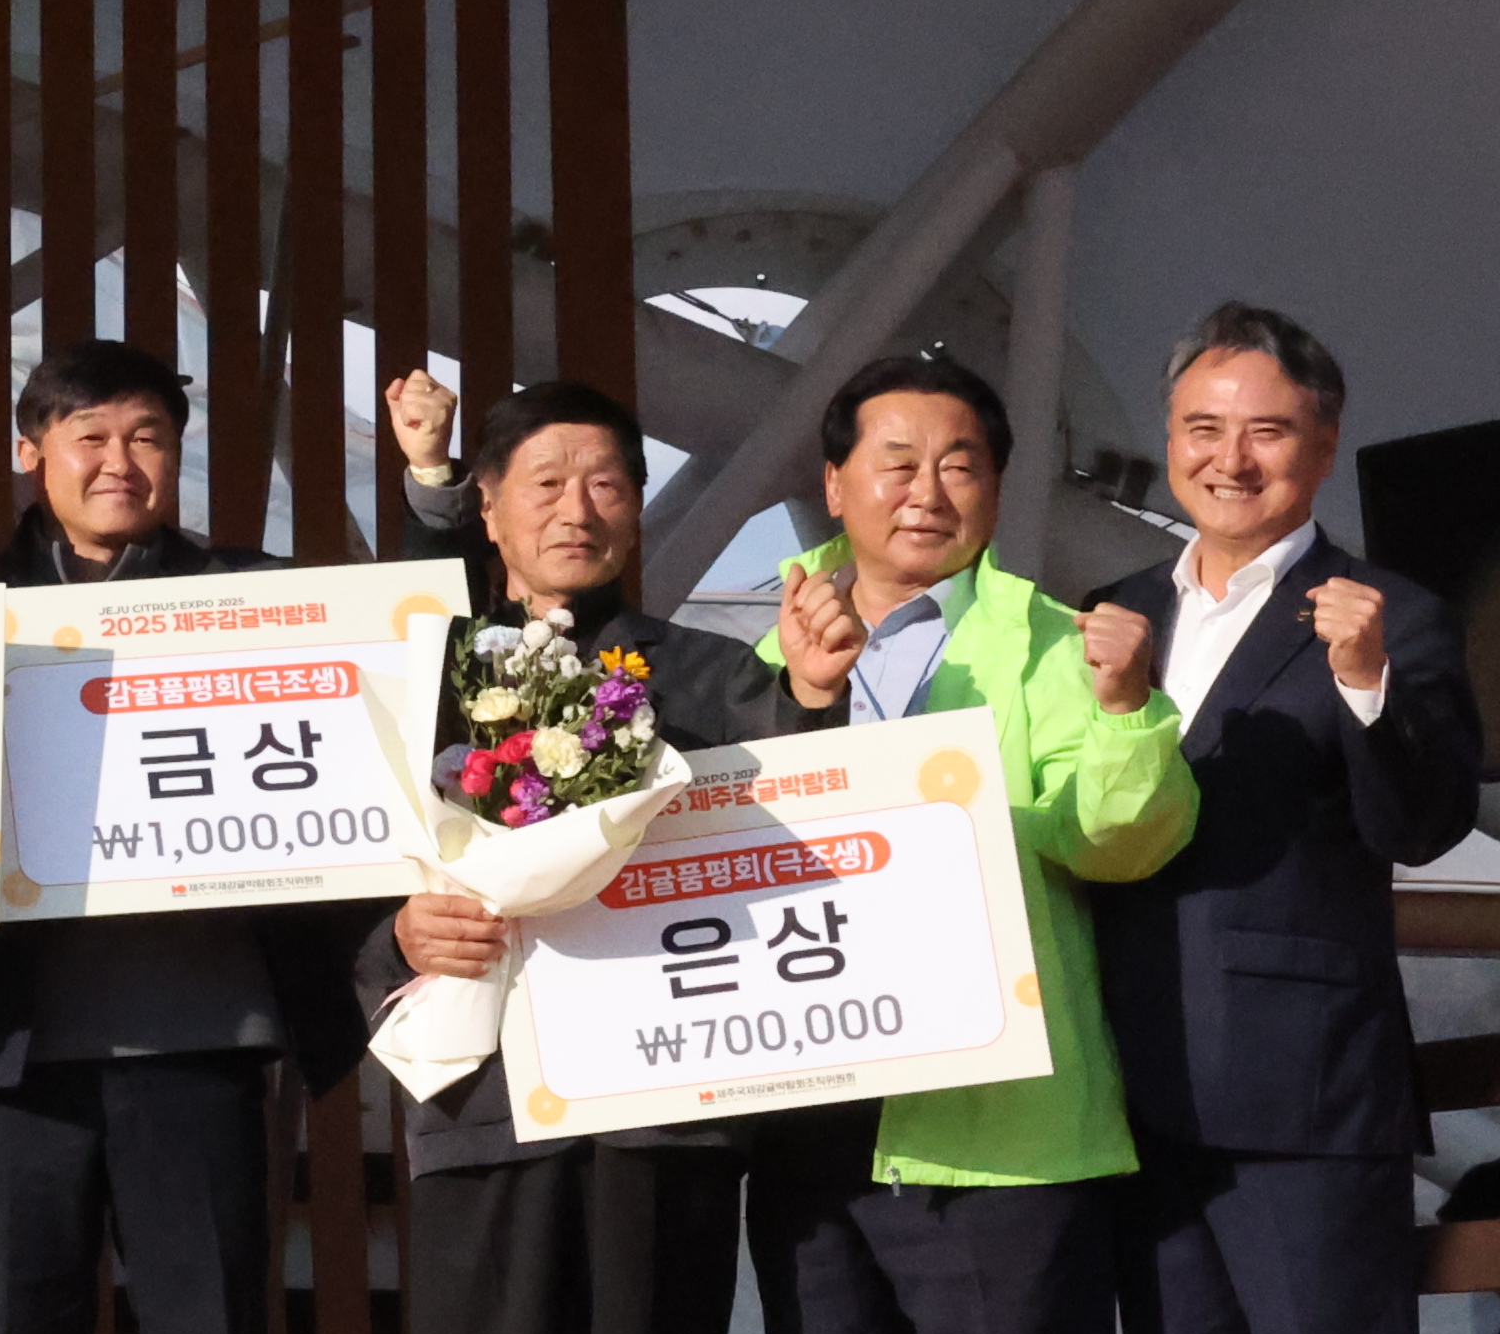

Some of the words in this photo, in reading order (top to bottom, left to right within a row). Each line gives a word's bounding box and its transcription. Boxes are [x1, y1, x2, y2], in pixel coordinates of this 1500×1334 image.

[99, 605, 130, 616] JEJU
[132, 602, 177, 614] CITRUS
[180, 599, 214, 610] EXPO
[218, 597, 245, 607] 2025
[100, 614, 167, 638] 2025
[173, 602, 327, 633] 제주감귤박람회
[104, 665, 350, 709] 감귤품평회(극조생)
[688, 767, 848, 812] 제주감귤박람회
[694, 772, 730, 786] EXPO
[733, 768, 761, 781] 2025
[621, 837, 875, 902] 감귤품평회(극조생)
